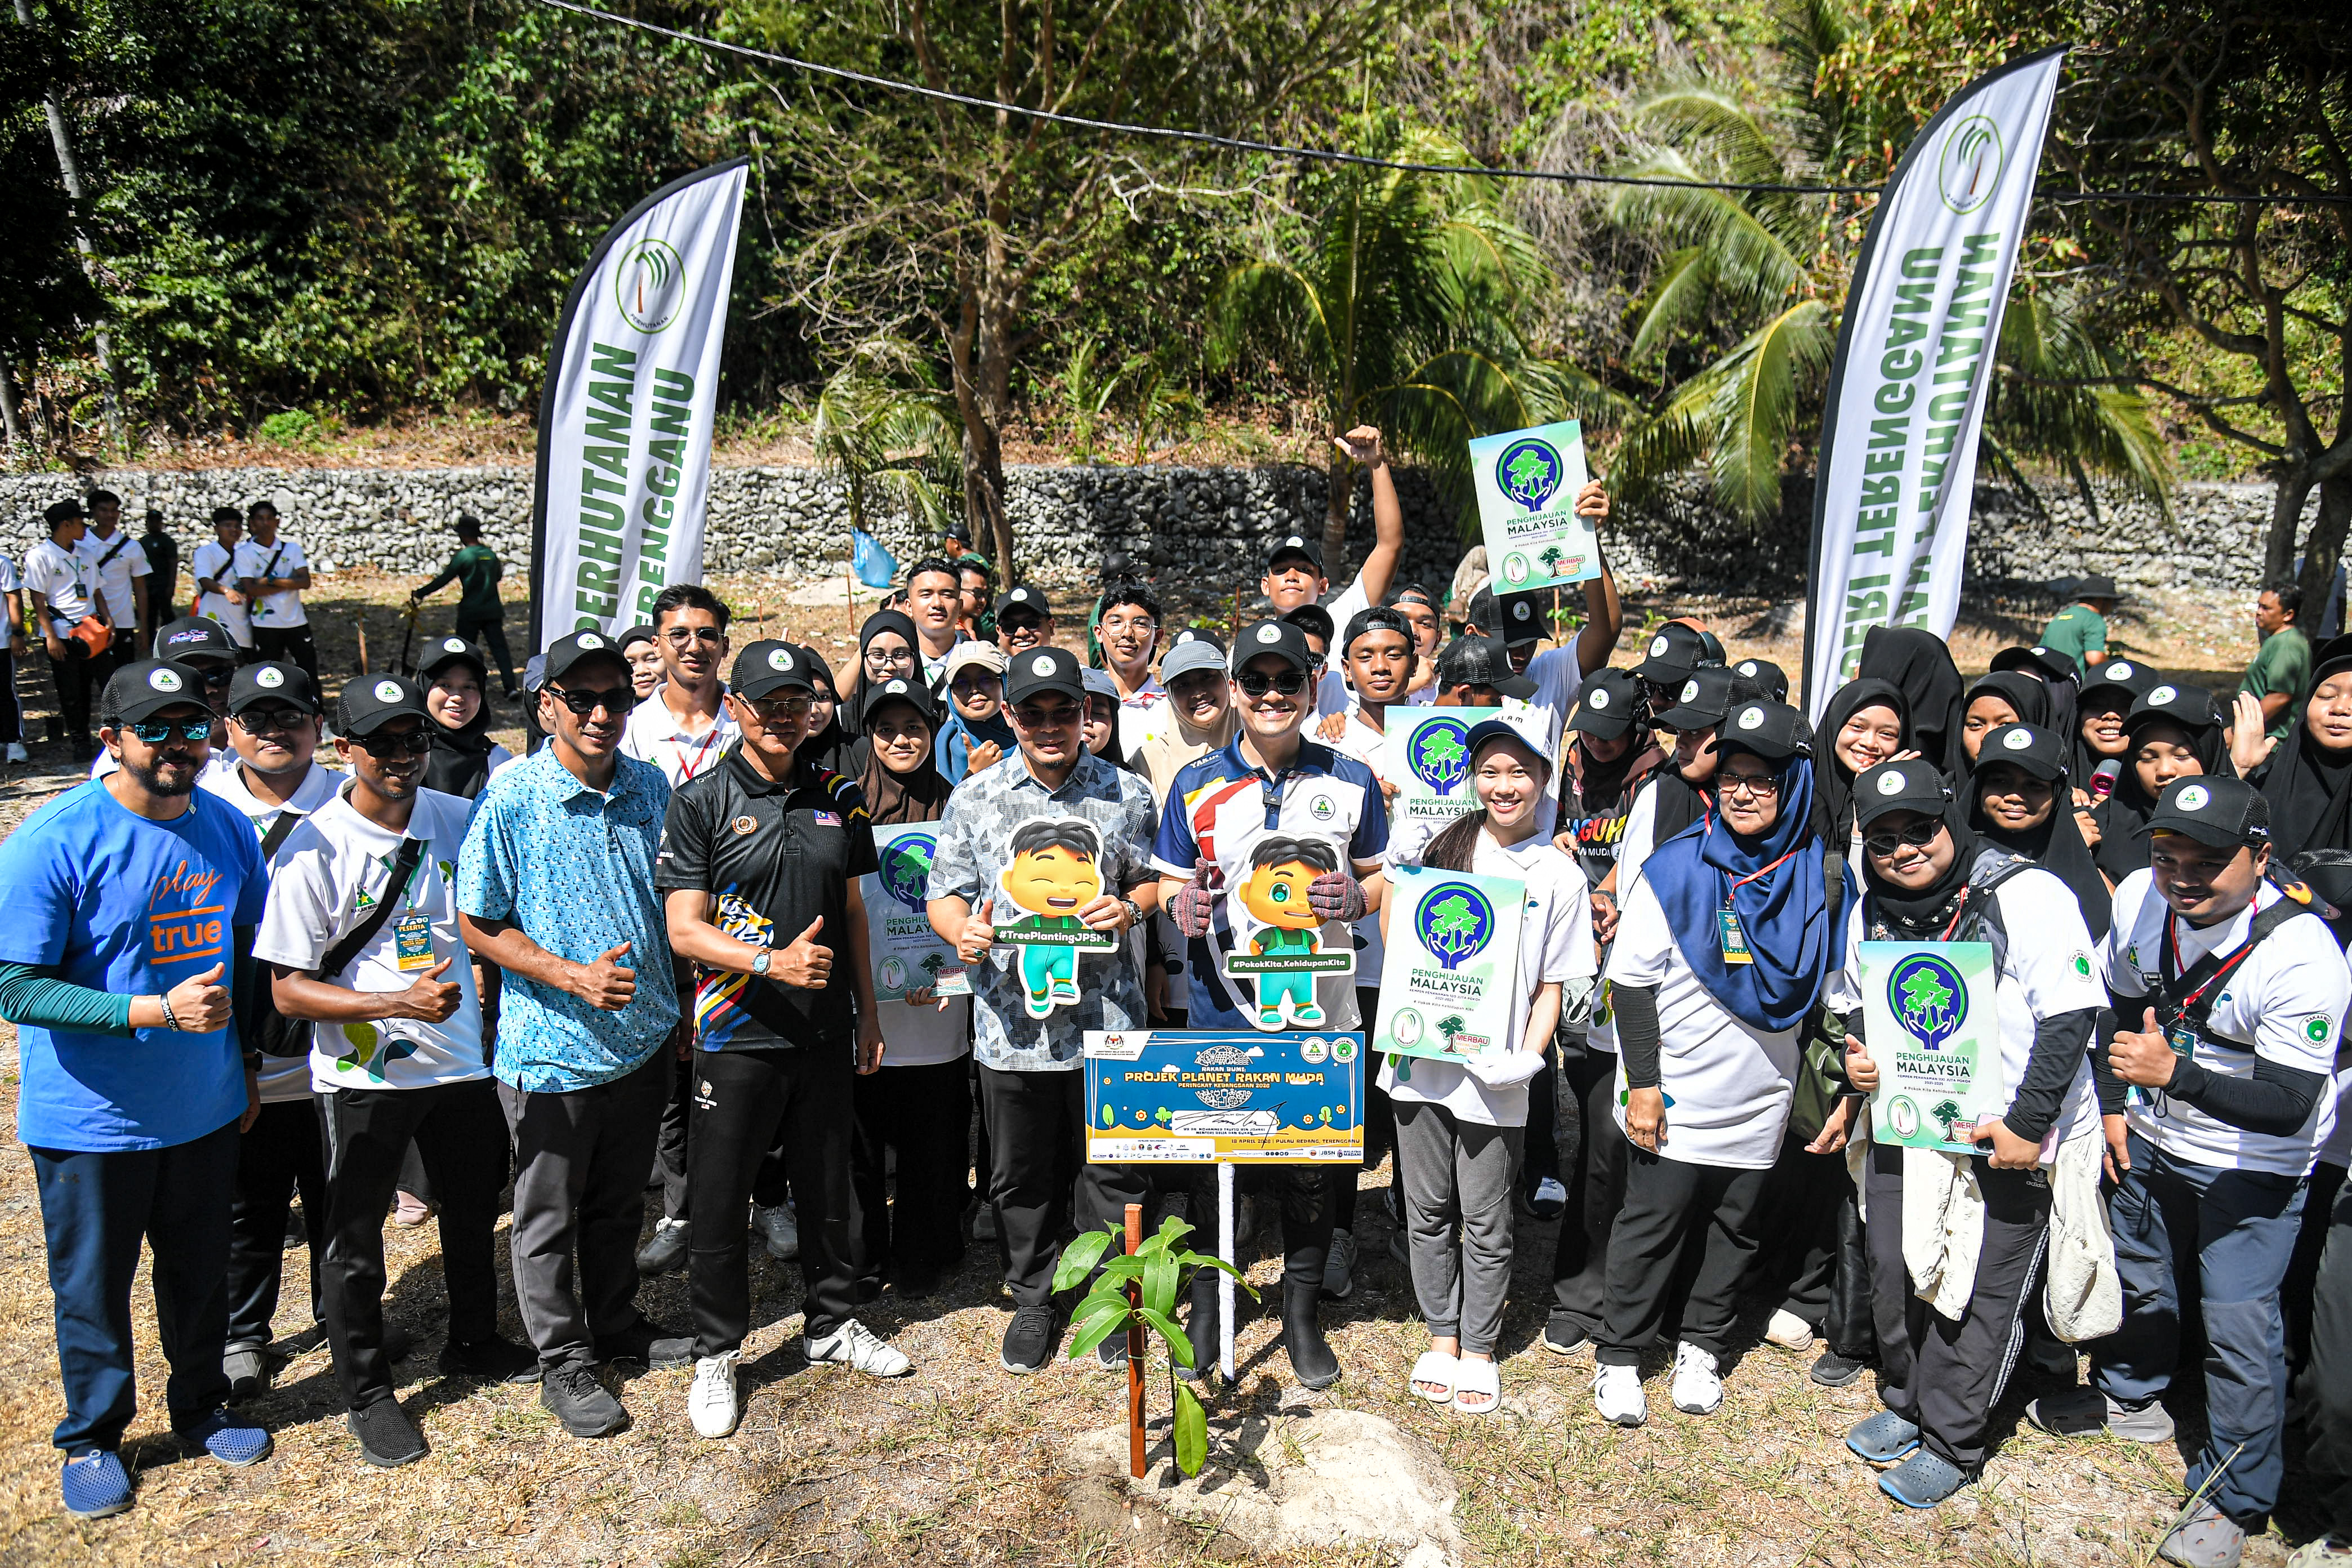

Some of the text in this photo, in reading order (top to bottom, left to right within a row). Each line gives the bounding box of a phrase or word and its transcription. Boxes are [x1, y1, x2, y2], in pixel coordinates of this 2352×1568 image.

[630, 313, 670, 329] PERHUTANAN
[635, 367, 695, 627] RENGGANU
[1507, 510, 1566, 526] PENGHIJAUAN
[1507, 517, 1567, 535] MALAYSIA
[1557, 556, 1583, 565] MERBAU
[1190, 754, 1219, 768] YAKIN
[1410, 806, 1473, 816] MALAYSIA
[1566, 814, 1627, 844] AGUH
[1588, 848, 1611, 857] MUDA
[149, 859, 224, 911] play
[886, 916, 929, 925] PENGHIJ
[150, 919, 222, 952] true
[887, 924, 931, 936] MALAY
[999, 930, 1106, 944] #TreePlantingJPSM
[939, 966, 969, 975] MERBAU
[1233, 959, 1346, 968] #PokokKita,KehidupanKita
[1412, 968, 1483, 985] PENGHIJAUAN
[1410, 977, 1481, 996] MALAYSIA
[168, 1020, 180, 1032] CAR
[1455, 1034, 1489, 1045] MERBAU
[1896, 1052, 1970, 1064] PENGHIJAUAN
[1896, 1061, 1970, 1077] MALAYSIA
[1124, 1072, 1324, 1083] PROJEK PLANET RAKAN MUDA
